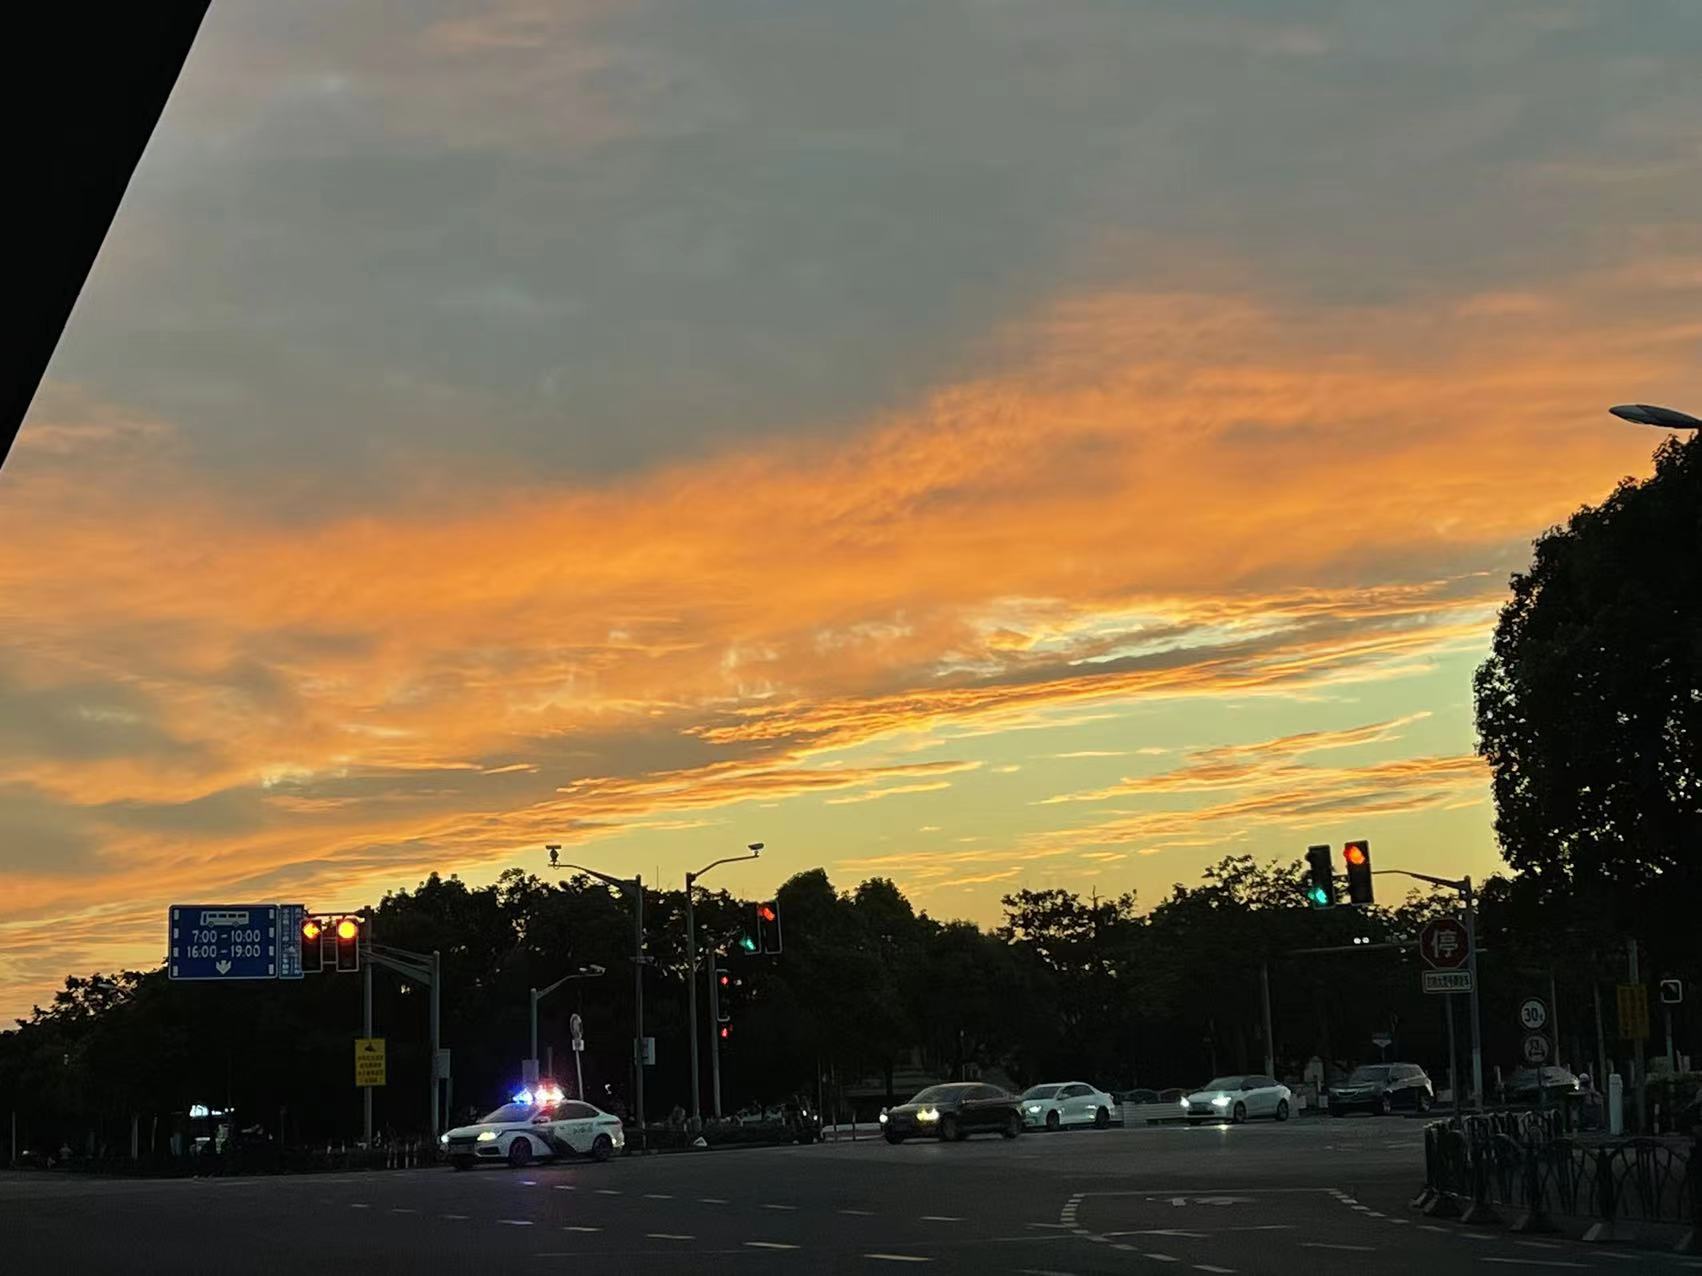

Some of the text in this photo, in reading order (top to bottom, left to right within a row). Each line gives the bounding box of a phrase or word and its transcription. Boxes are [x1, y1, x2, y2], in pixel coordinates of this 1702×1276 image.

[192, 930, 217, 943] 7:00
[231, 929, 261, 942] 10:00
[1430, 929, 1458, 958] 停
[187, 945, 217, 958] 16:00
[231, 944, 261, 957] 19:00
